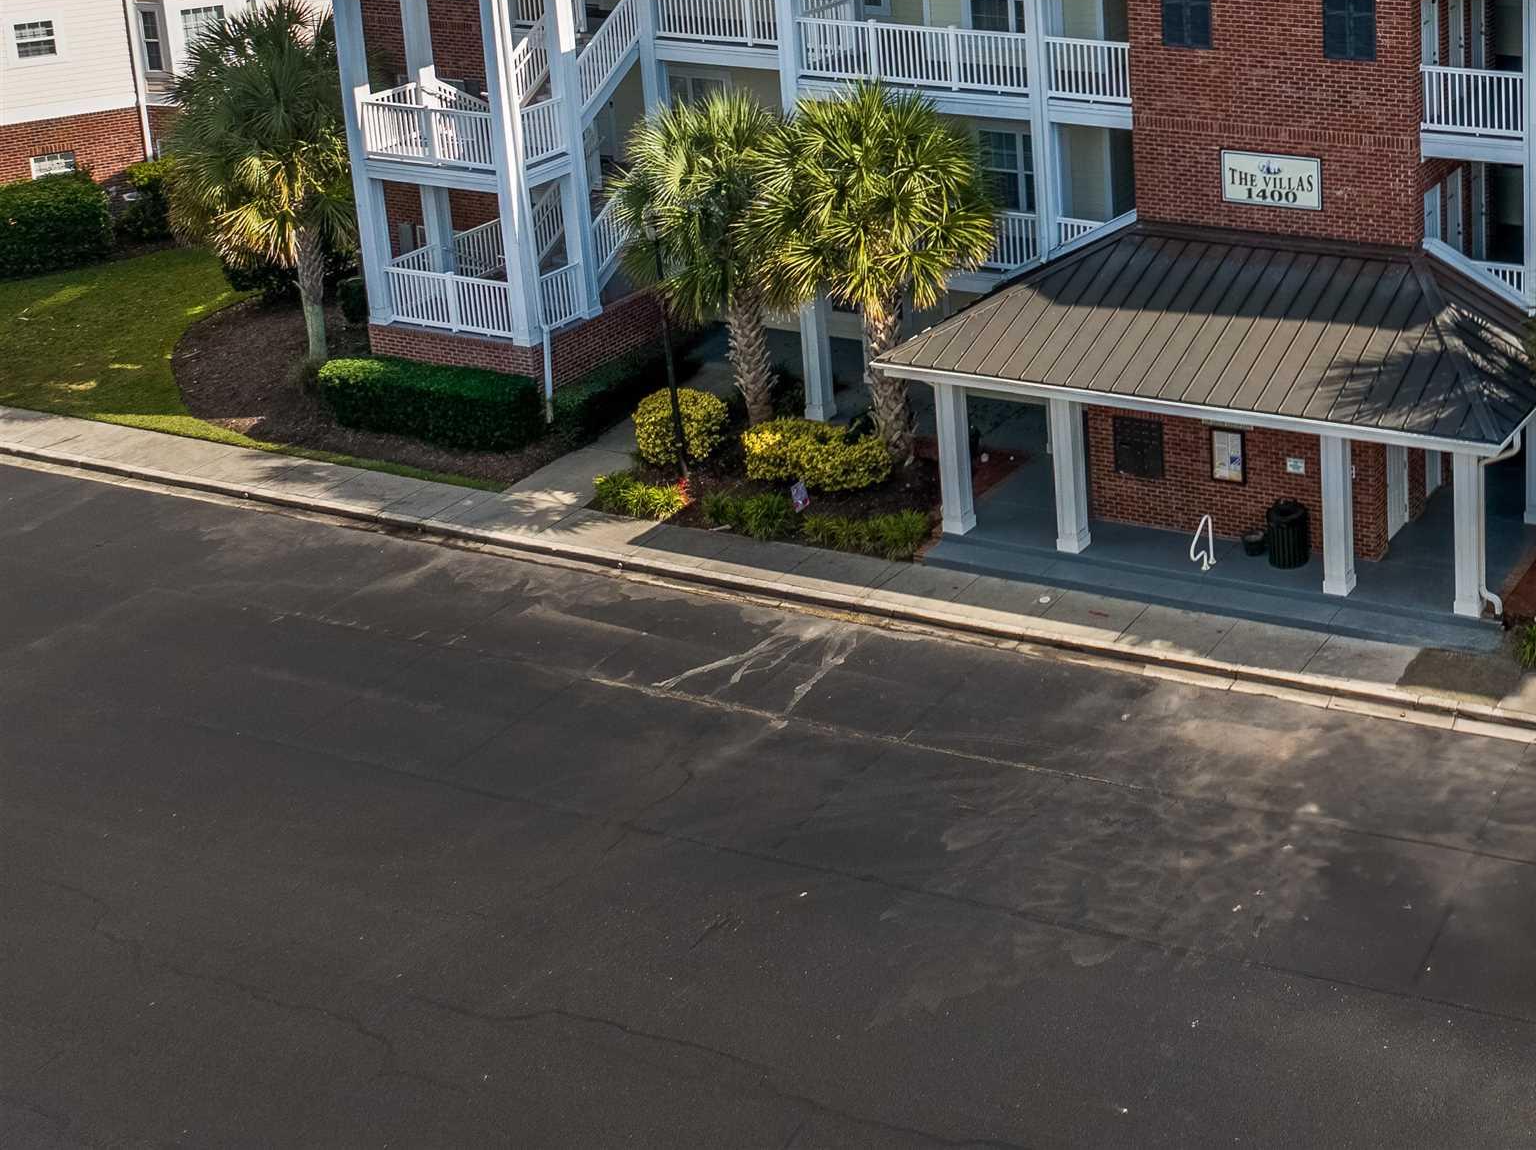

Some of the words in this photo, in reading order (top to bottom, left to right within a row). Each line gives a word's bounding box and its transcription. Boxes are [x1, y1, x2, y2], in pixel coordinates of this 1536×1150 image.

[1229, 167, 1257, 187] THE
[1263, 175, 1313, 192] VILLAS
[1246, 188, 1297, 203] 1400
